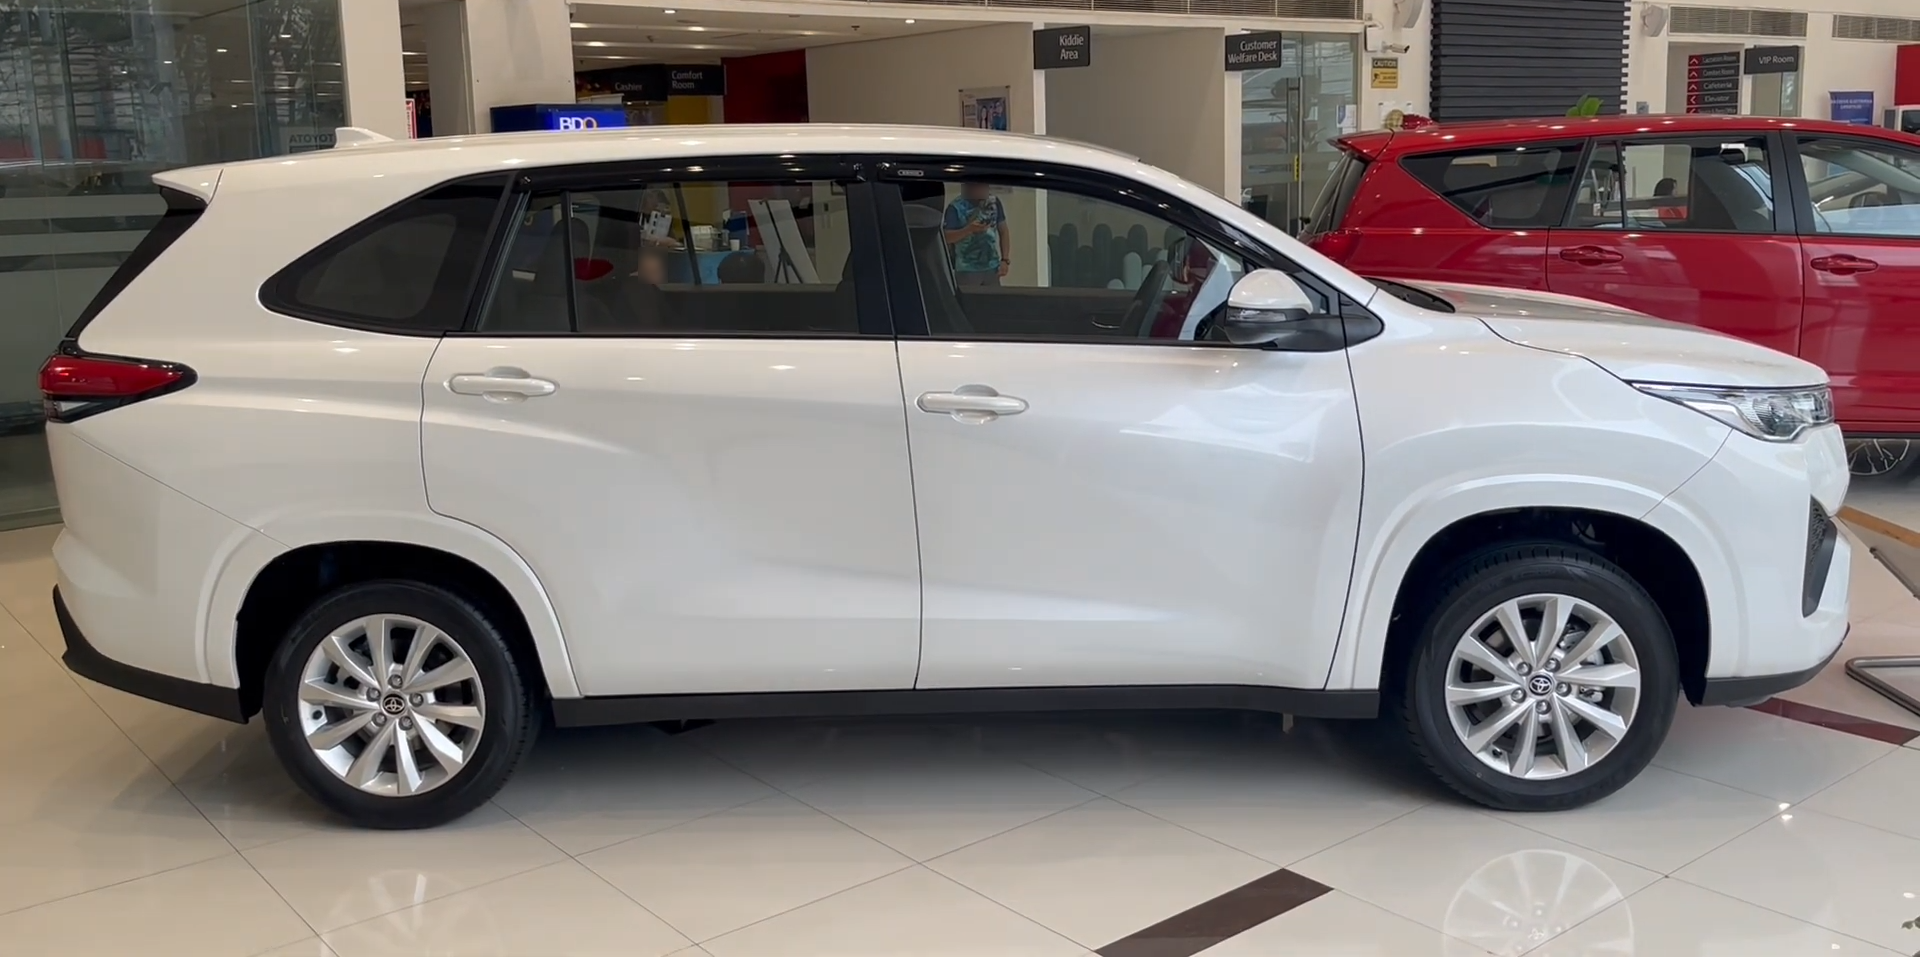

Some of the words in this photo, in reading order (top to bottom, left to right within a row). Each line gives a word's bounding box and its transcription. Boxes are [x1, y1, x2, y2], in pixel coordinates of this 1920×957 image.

[1059, 34, 1084, 46] Kiddie
[1240, 40, 1277, 51] Customer
[1060, 48, 1079, 60] Area
[1227, 52, 1257, 64] Welfare
[1257, 50, 1278, 62] Desk
[1758, 56, 1772, 65] VIP
[1772, 55, 1795, 64] Room
[671, 70, 703, 80] Comfort
[614, 82, 643, 91] Cashier
[671, 80, 695, 89] Room
[1703, 82, 1733, 90] Cafeteria
[559, 116, 598, 131] BDO
